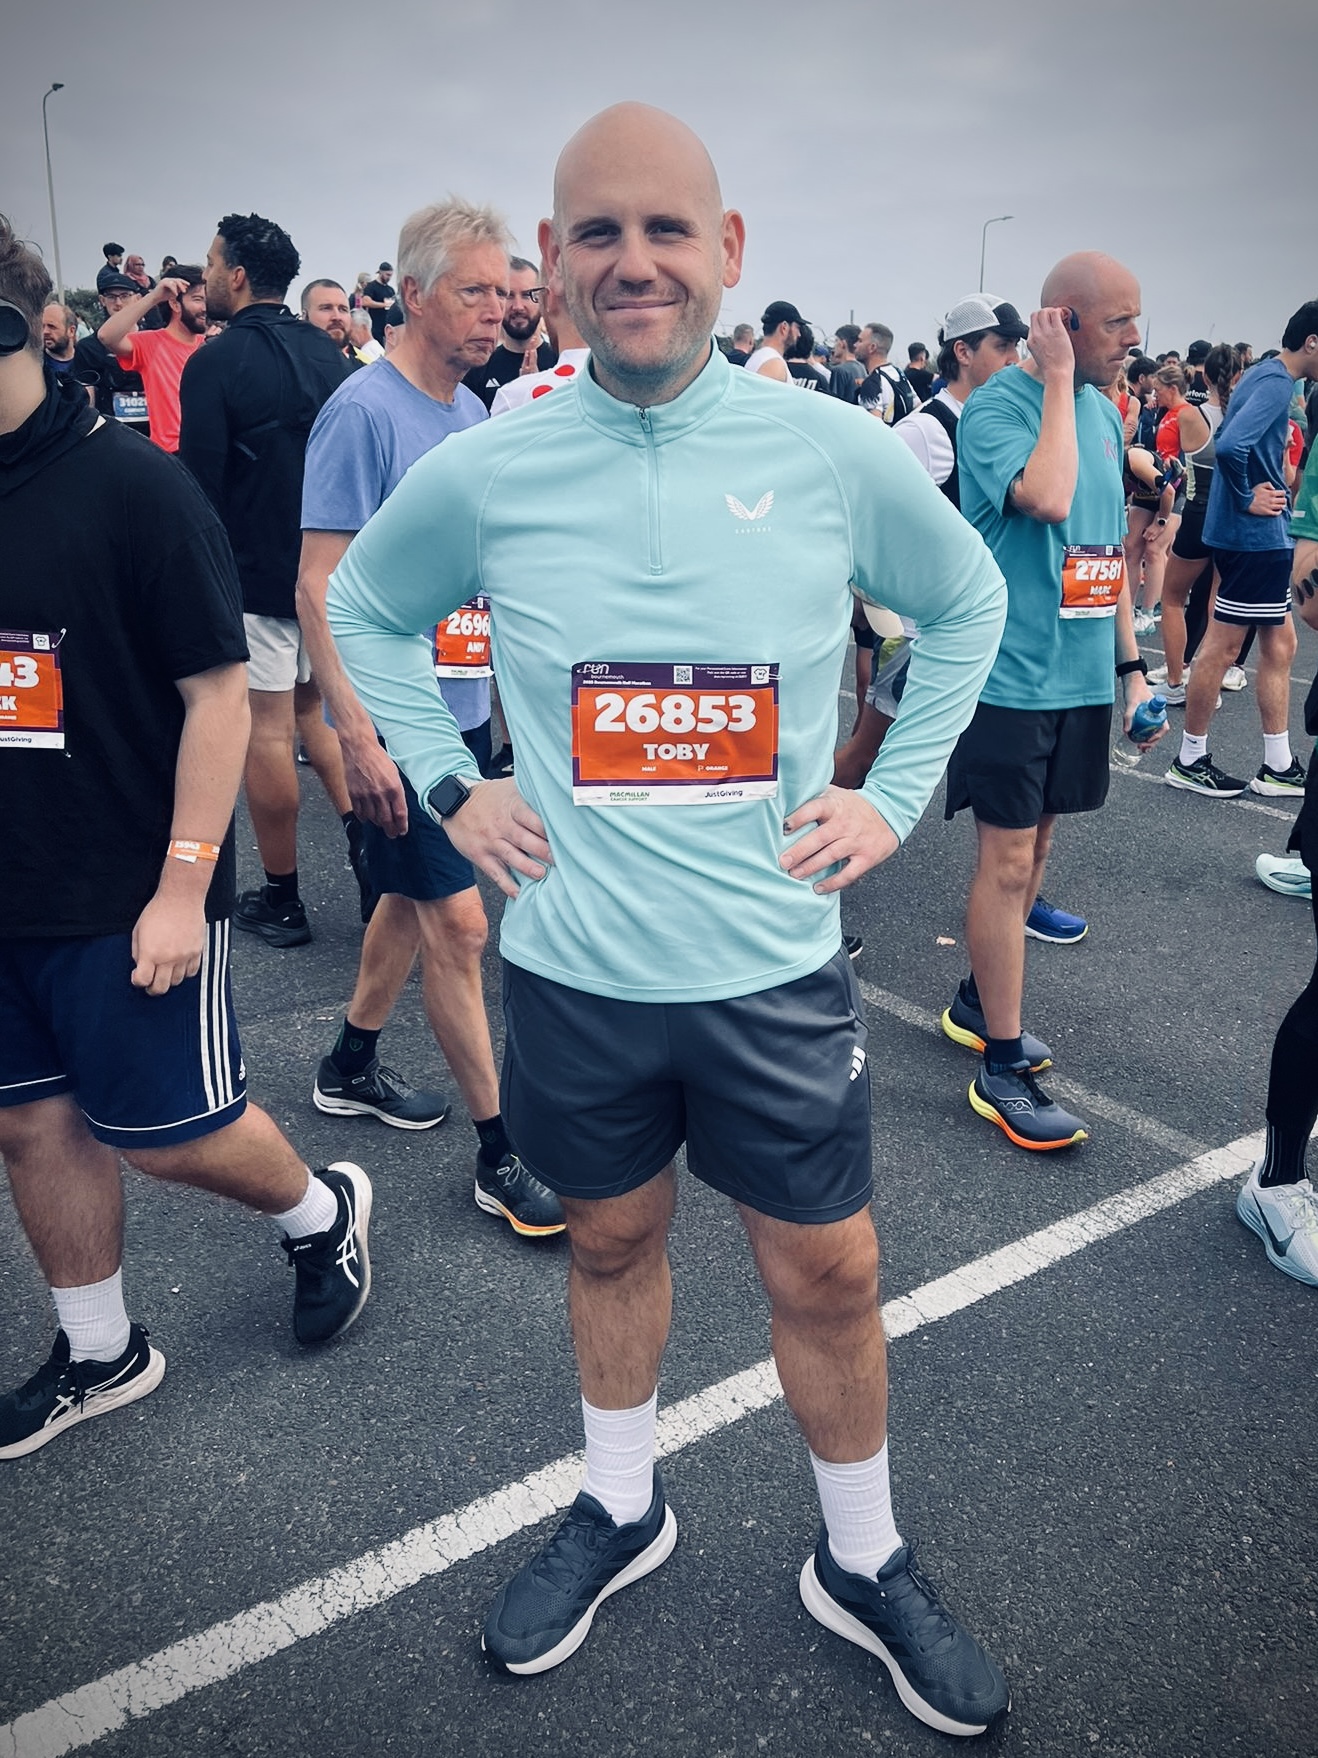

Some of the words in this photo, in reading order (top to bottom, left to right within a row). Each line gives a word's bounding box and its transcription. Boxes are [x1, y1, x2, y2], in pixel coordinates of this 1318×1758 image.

[119, 397, 147, 406] 3102
[1075, 559, 1123, 581] 27581
[446, 610, 490, 636] 2696
[0, 695, 18, 711] K
[594, 692, 757, 734] 26853
[642, 743, 710, 761] TOBY
[704, 790, 743, 798] JustGiving
